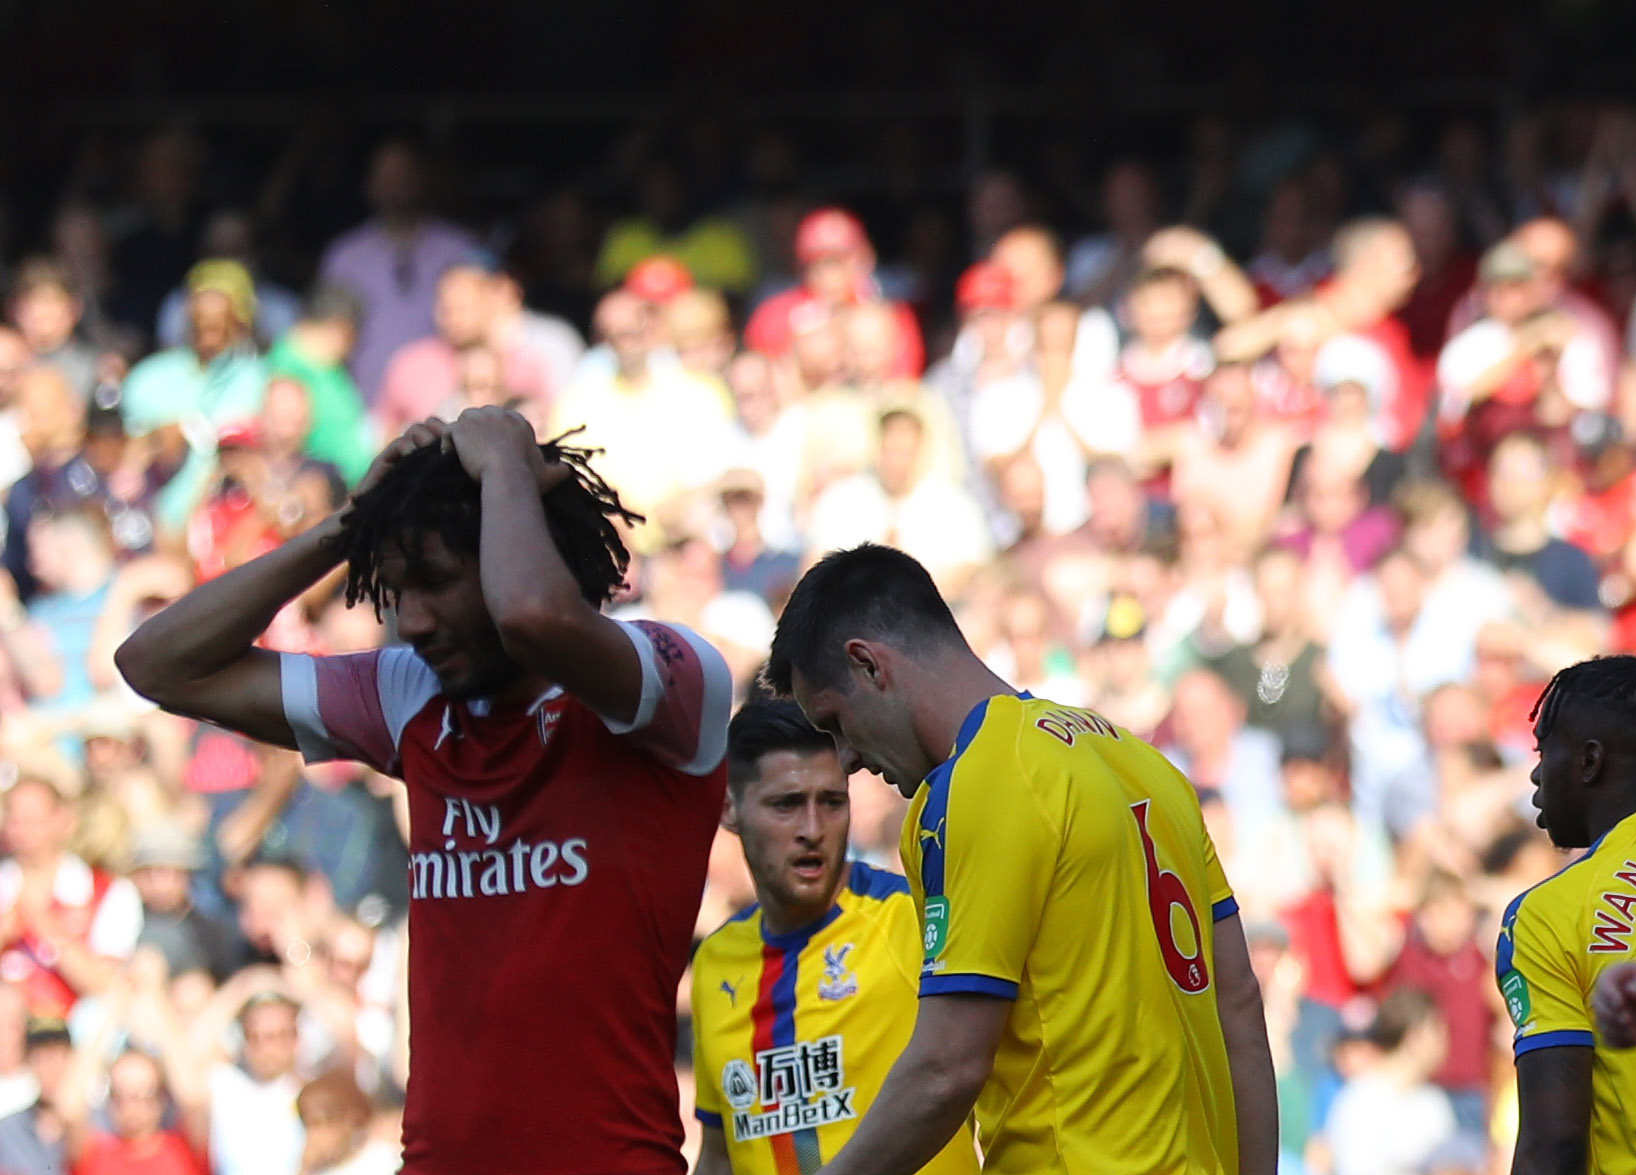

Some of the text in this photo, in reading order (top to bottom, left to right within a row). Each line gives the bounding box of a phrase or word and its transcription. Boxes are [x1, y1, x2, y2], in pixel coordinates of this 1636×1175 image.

[442, 798, 500, 844] Fly
[409, 837, 589, 900] mirates
[1130, 798, 1210, 994] 6
[758, 1040, 839, 1102] 万博
[735, 1092, 852, 1138] ManBetX
